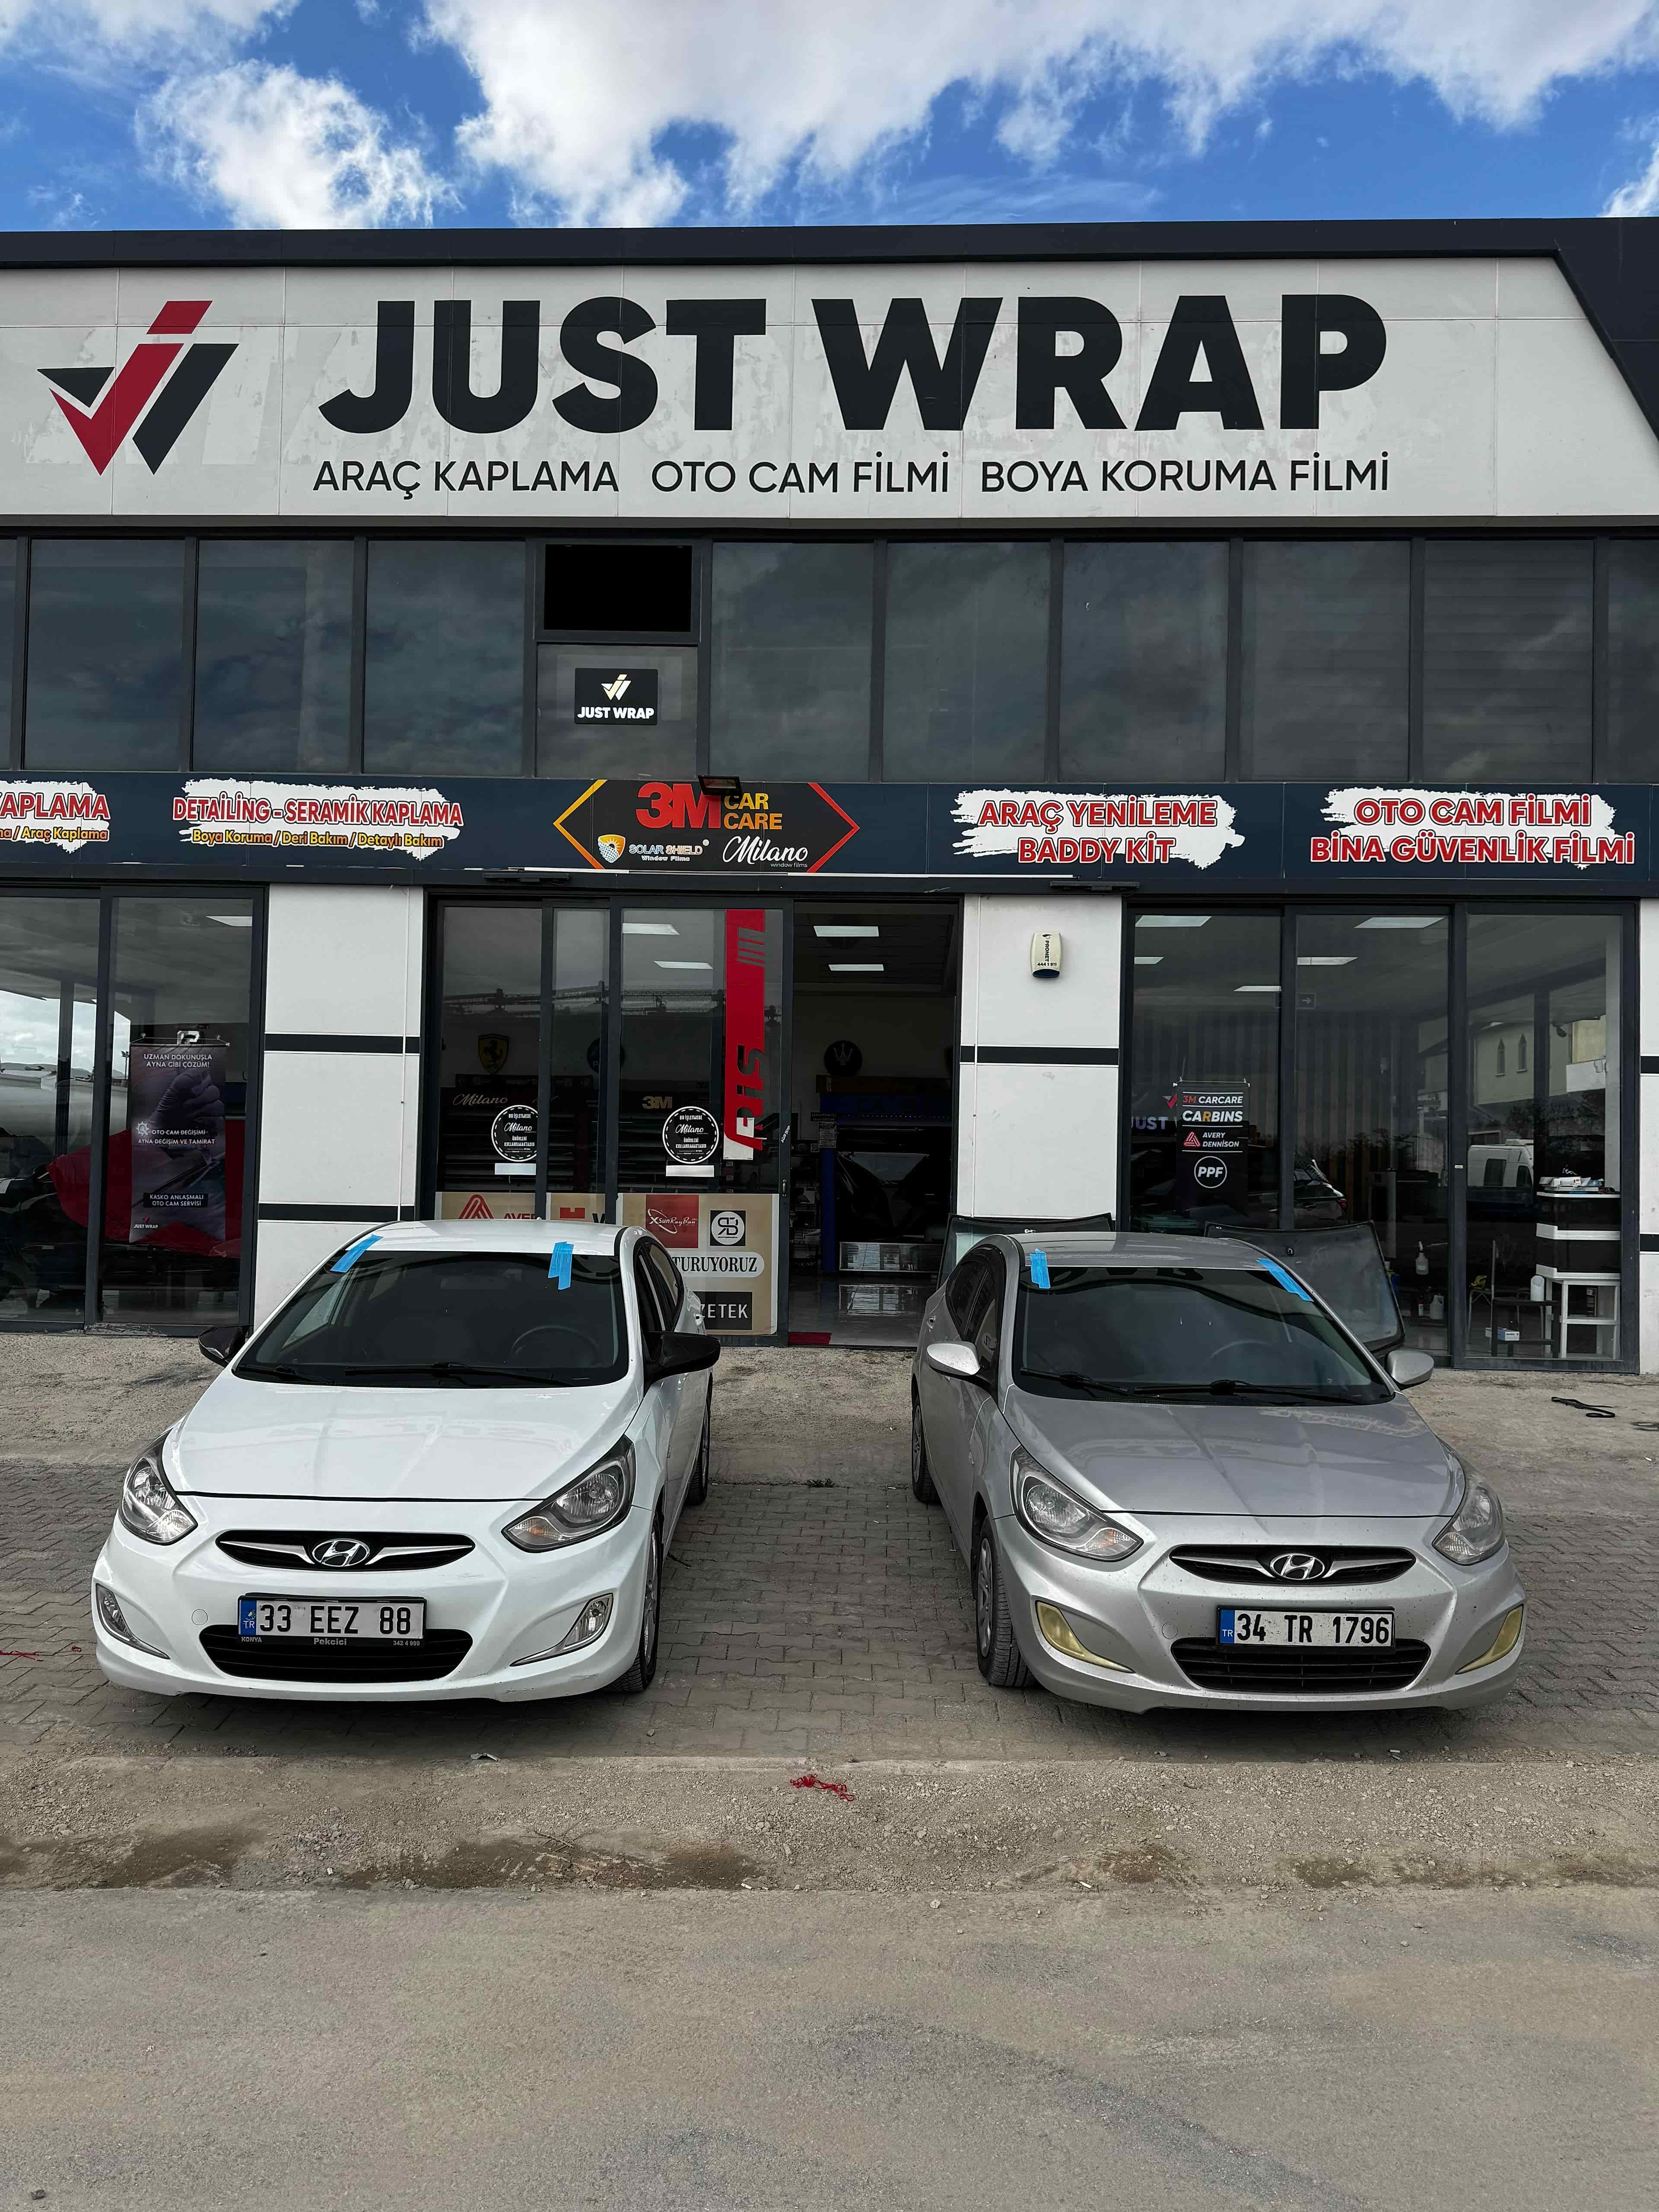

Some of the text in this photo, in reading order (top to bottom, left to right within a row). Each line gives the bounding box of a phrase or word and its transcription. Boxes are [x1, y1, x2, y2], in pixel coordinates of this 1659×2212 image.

[318, 295, 1386, 433] JUST WRAP
[314, 461, 618, 500] ARAÇ KAPLAMA
[652, 451, 949, 493] OTO CAM FİLMİ
[982, 451, 1389, 493] BOYA KORUMA FİLMİ
[577, 707, 654, 718] JUST WRAP
[0, 794, 109, 818] APLAMA
[173, 792, 269, 821] DETAİLİNG
[285, 795, 370, 824] SERAMİK
[372, 802, 462, 826] KAPLAMA
[636, 782, 769, 830] 3M CAR
[979, 796, 1217, 832] ARAÇ YENİLEME
[1356, 795, 1591, 825] OTO CAM FİLMİ
[22, 827, 51, 841] Araç
[54, 827, 108, 841] Kaplama
[724, 813, 782, 830] CARE
[193, 830, 223, 845] Boya
[225, 831, 272, 844] Koruma
[283, 831, 308, 845] Deri
[310, 833, 347, 845] Bakım
[359, 834, 402, 849] Detaylı
[405, 835, 442, 847] Bakım
[629, 844, 703, 855] SOLAR SHIELD
[722, 835, 808, 864] Milano
[1019, 832, 1176, 863] BADDY KİT
[1311, 830, 1634, 864] BİNA GÜVENLİK FİLMİ
[453, 1093, 508, 1106] Milano
[642, 1096, 673, 1109] 3M
[504, 1122, 532, 1132] Milano
[675, 1124, 704, 1134] Milano
[1182, 1110, 1243, 1122] CARBINS
[1198, 1166, 1224, 1177] PPF
[260, 1604, 411, 1634] 33 EEZ 88
[1237, 1613, 1389, 1644] 34 TR 1796
